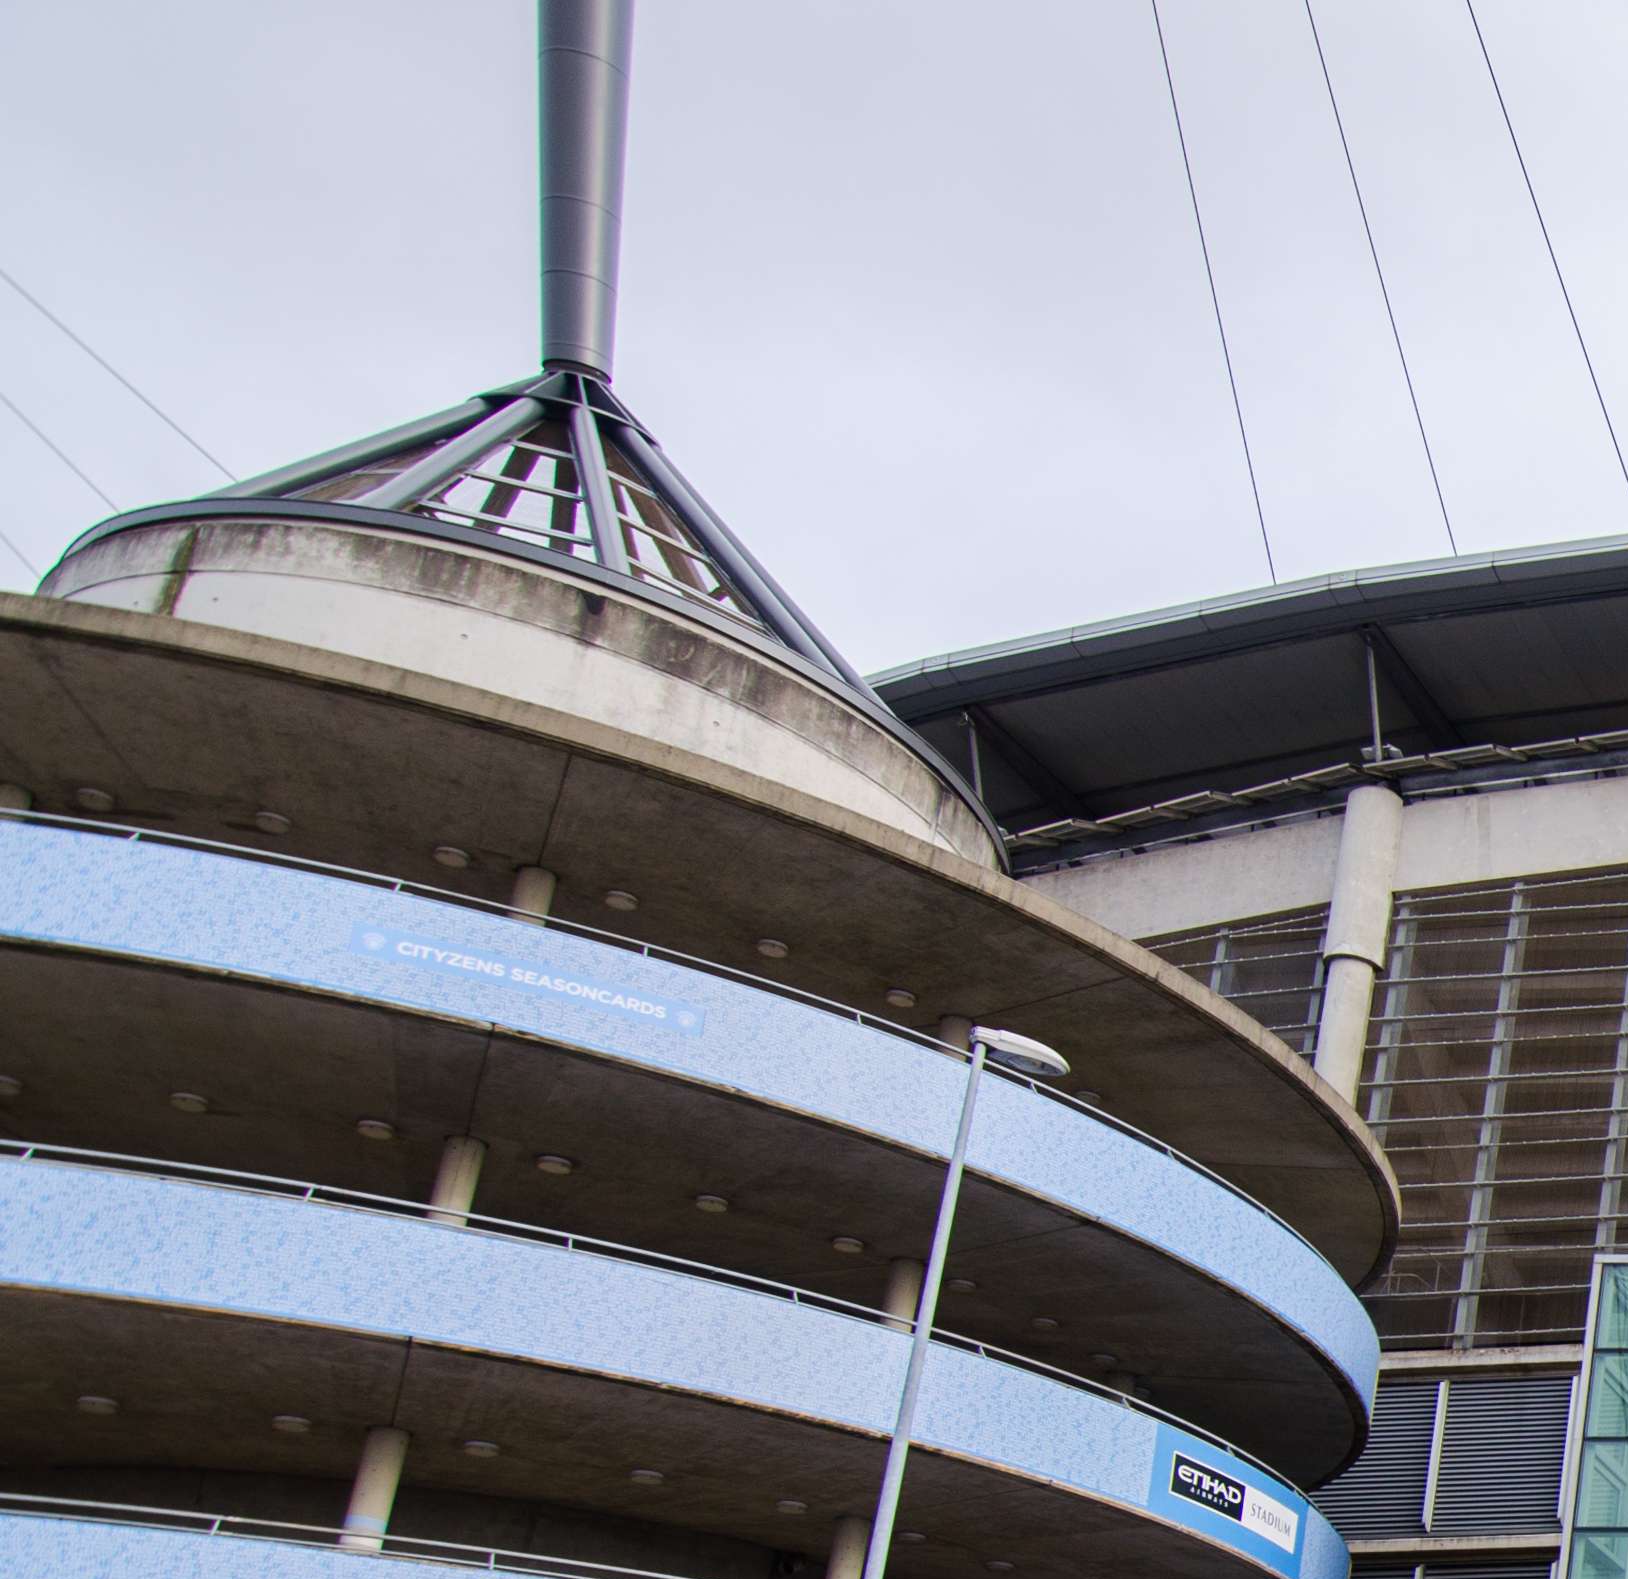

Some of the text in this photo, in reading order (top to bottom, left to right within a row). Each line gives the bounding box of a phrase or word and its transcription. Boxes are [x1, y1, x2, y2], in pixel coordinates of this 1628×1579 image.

[395, 940, 668, 1020] CITYZENS SEASONCARDS
[1177, 1464, 1291, 1537] ETIHAD STADIUM
